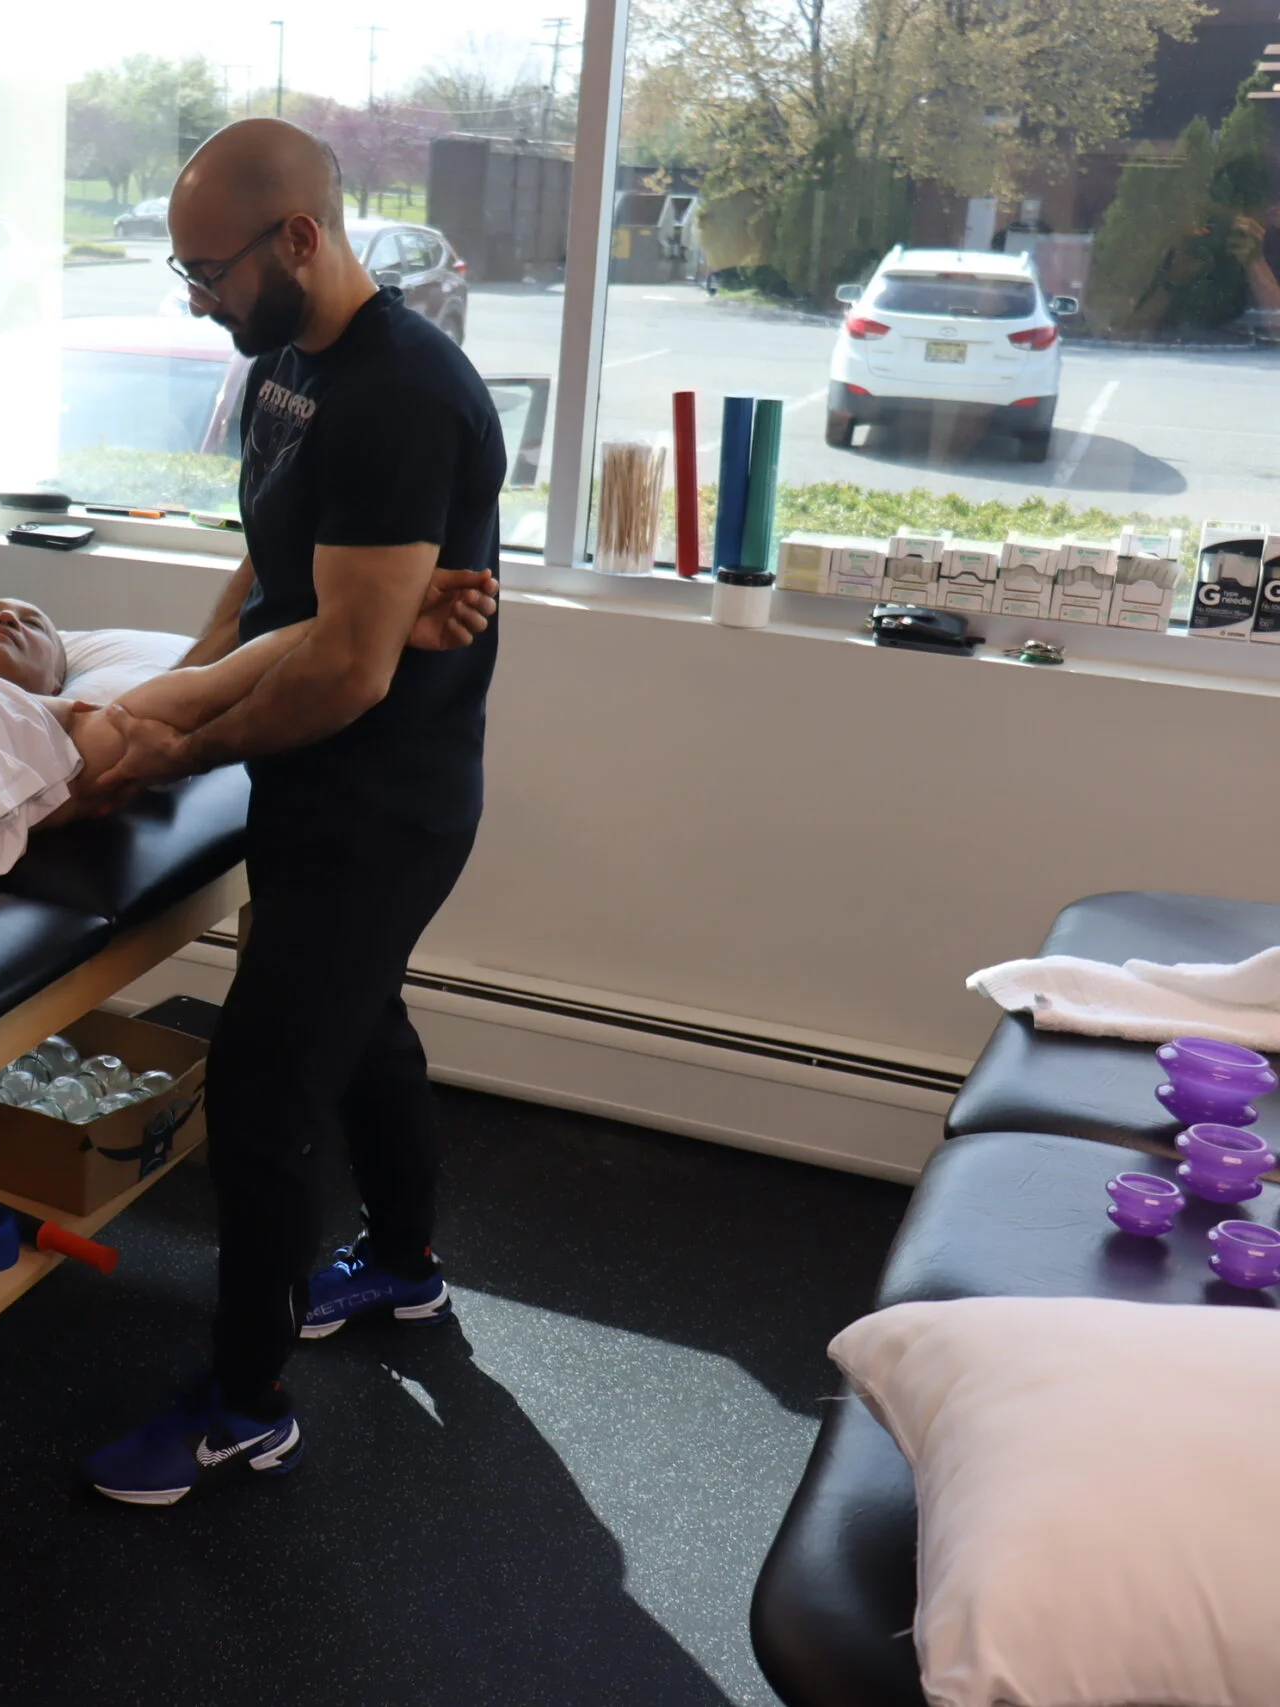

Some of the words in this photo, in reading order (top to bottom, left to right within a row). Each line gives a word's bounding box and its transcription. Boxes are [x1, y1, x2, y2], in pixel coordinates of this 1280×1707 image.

[1199, 583, 1222, 606] G
[1221, 597, 1252, 606] needle
[304, 1285, 394, 1323] METCON
